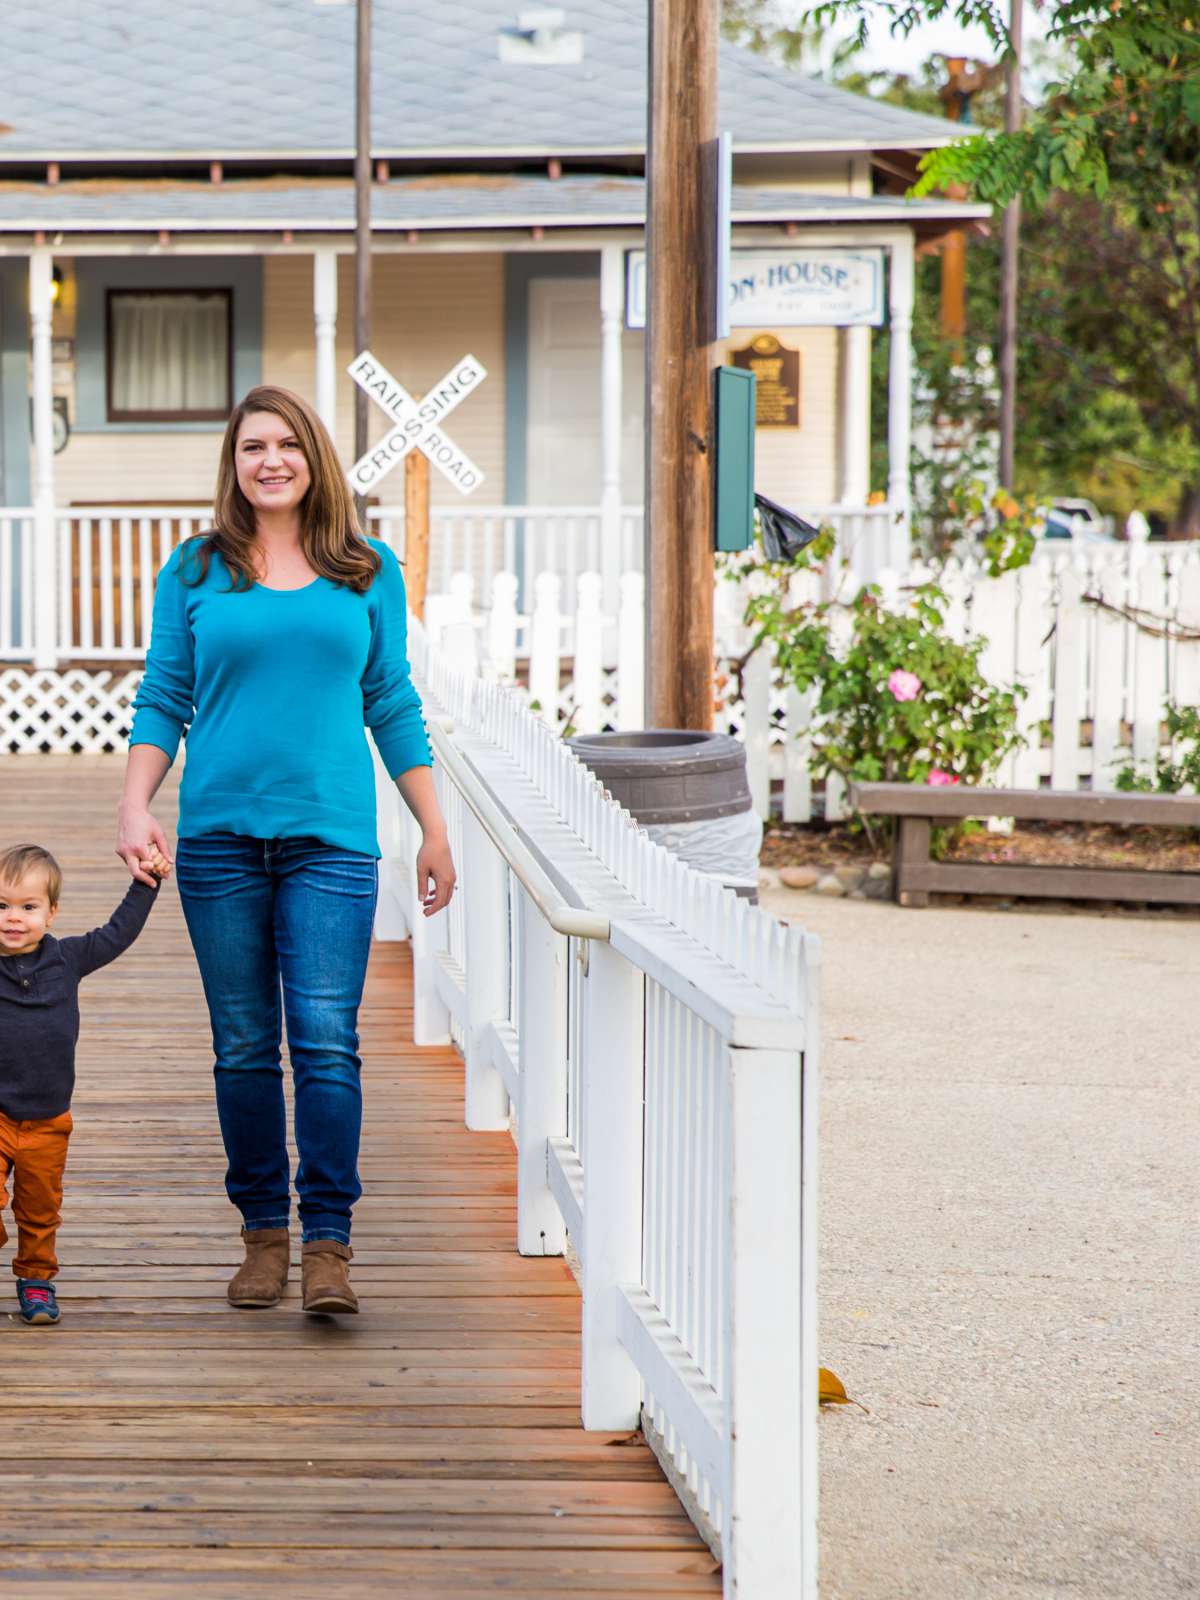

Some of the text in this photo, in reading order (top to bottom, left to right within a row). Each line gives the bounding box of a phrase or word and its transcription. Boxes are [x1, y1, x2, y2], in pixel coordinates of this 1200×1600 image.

[768, 262, 848, 291] HOUSE
[356, 361, 477, 487] RAIL ROAD
[356, 366, 477, 483] CROSSING
